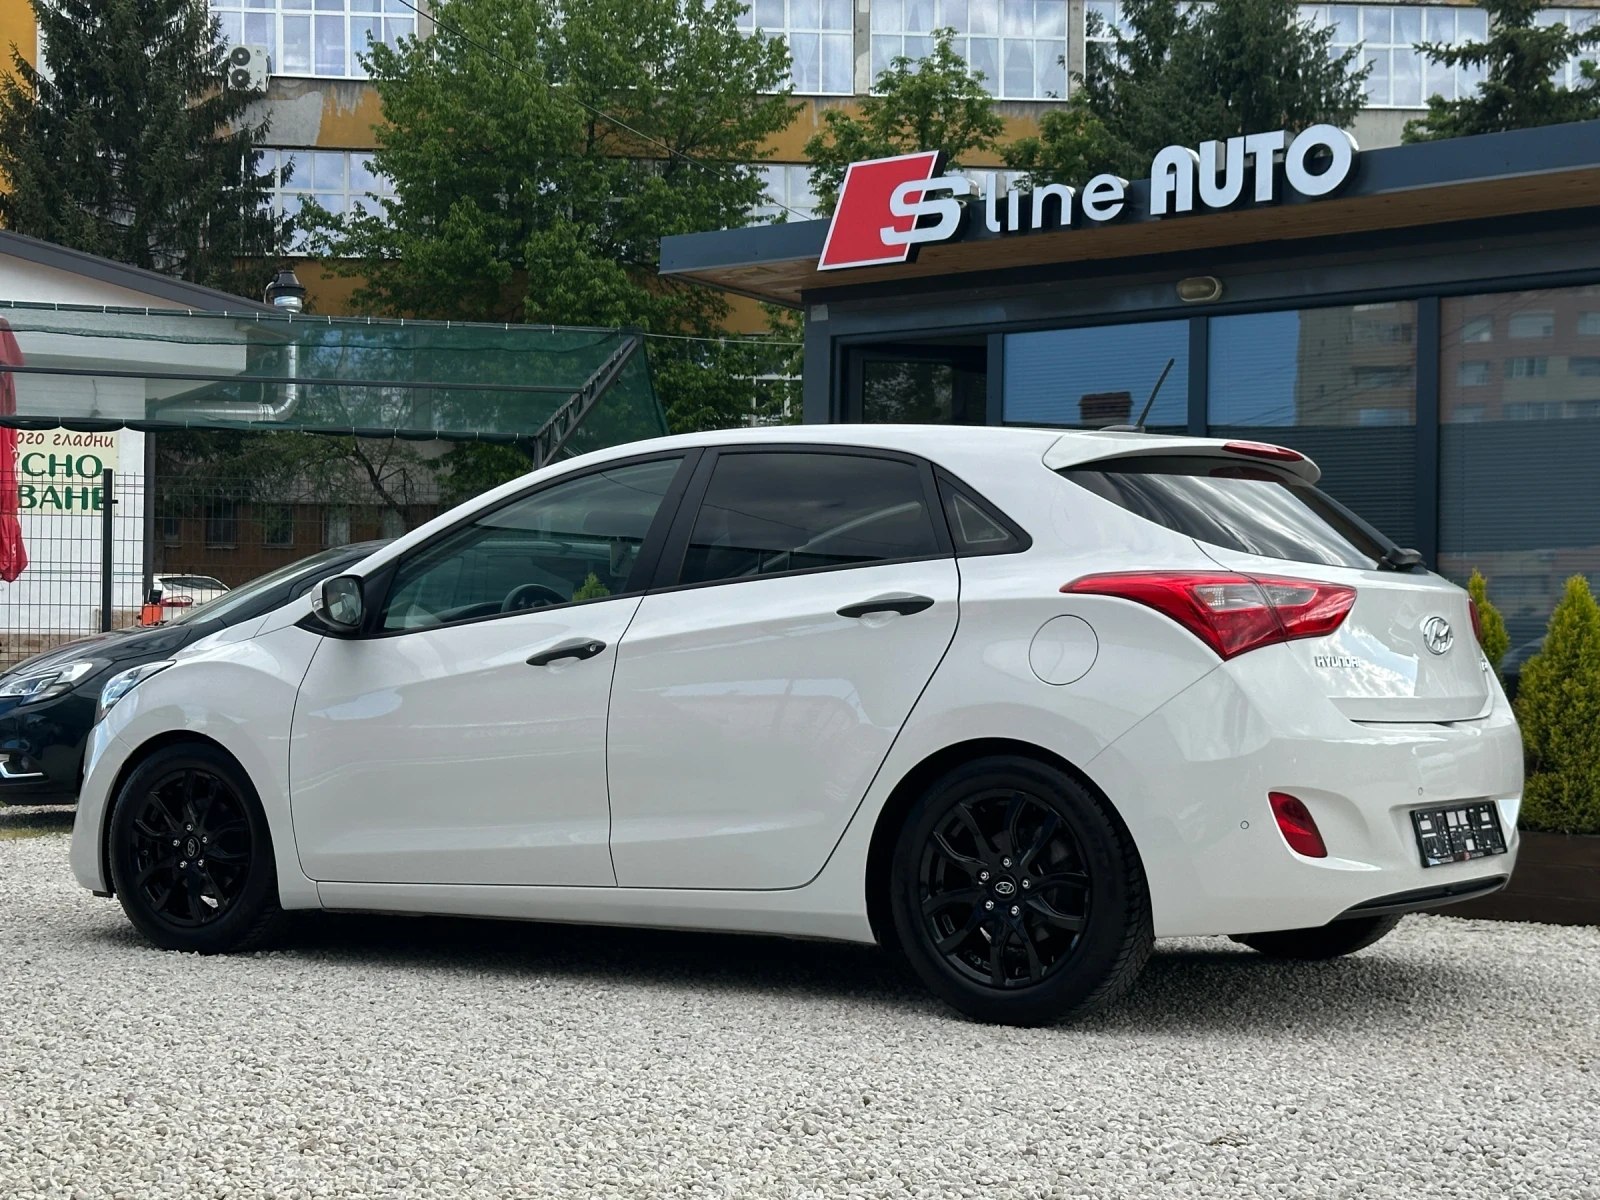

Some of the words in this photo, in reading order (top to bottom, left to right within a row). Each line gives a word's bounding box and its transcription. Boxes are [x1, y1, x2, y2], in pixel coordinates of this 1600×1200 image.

[880, 176, 971, 246] S
[986, 174, 1124, 232] line
[1150, 124, 1353, 215] AUTO
[53, 432, 114, 448] гладни
[16, 452, 103, 478] СНО
[1314, 655, 1360, 668] HYUNDAI
